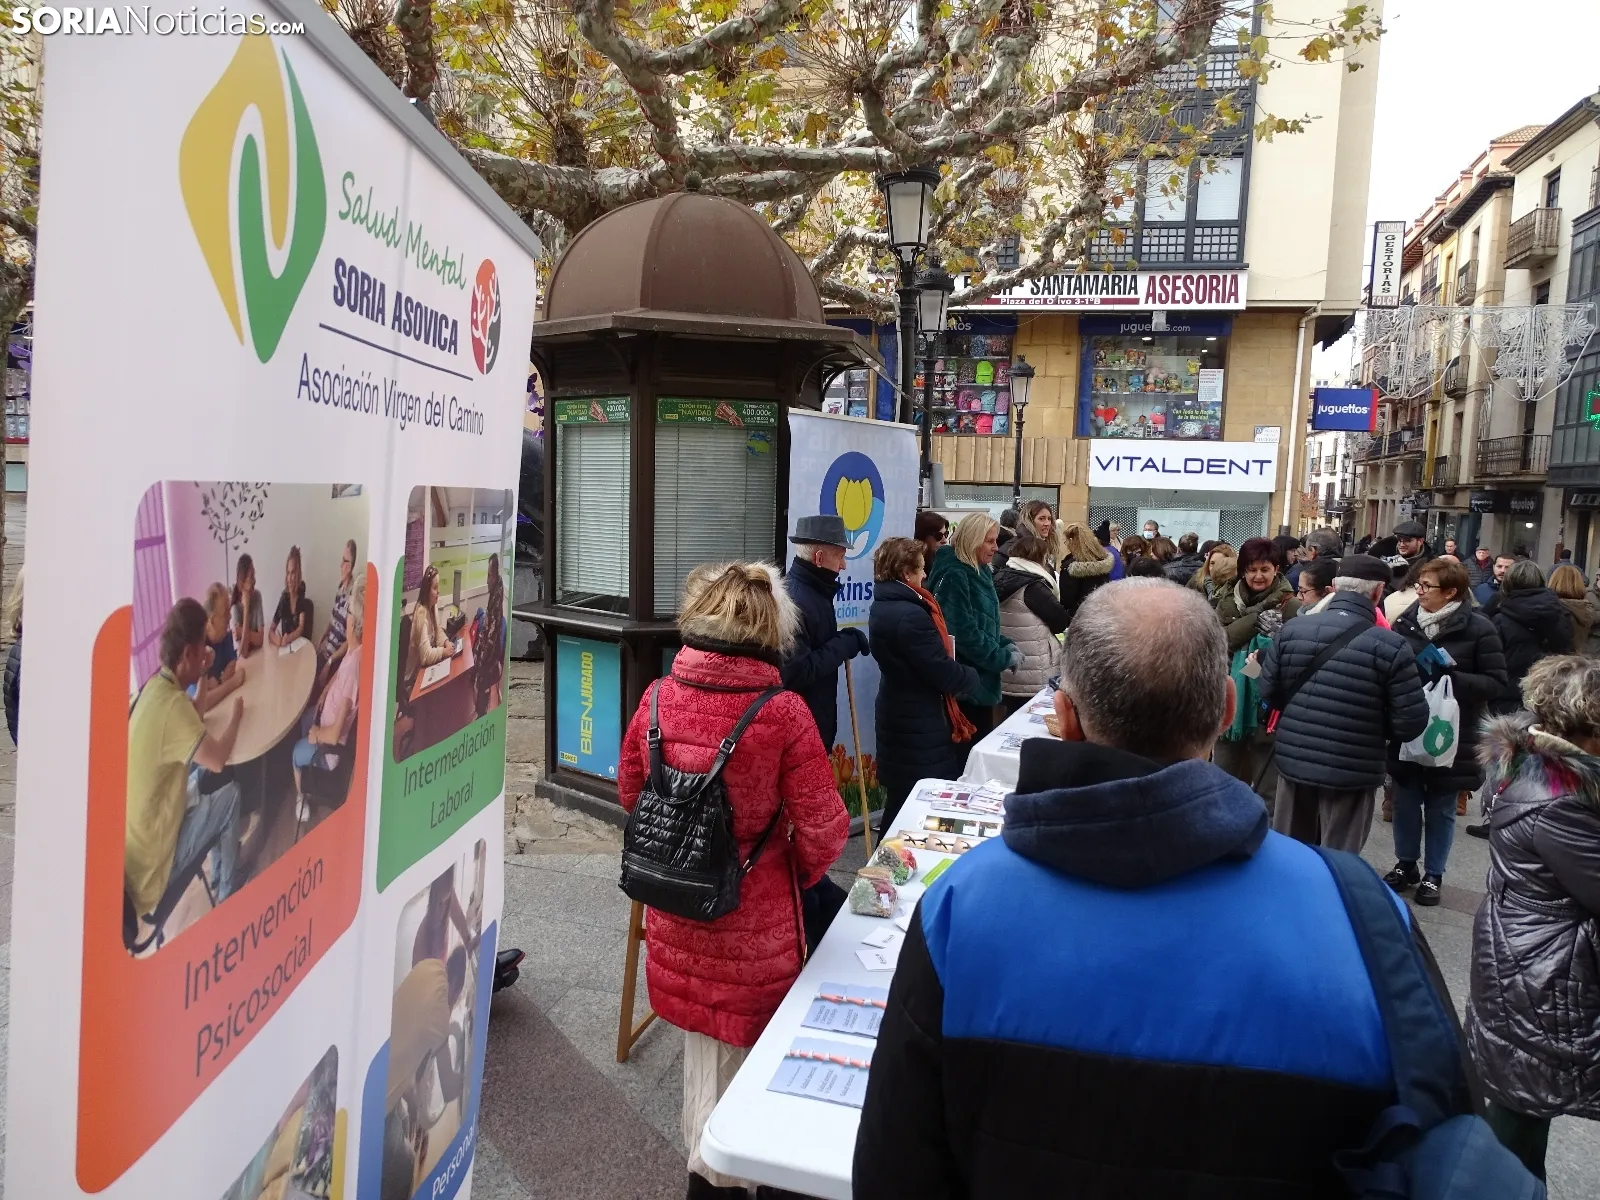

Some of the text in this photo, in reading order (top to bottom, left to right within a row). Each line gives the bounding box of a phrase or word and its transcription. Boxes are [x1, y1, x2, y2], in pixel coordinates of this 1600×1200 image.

[338, 171, 467, 290] Salud Mental
[1381, 235, 1396, 294] GESTORIAS
[333, 257, 458, 355] SORIA ASOVICA
[1000, 297, 1026, 306] Plaza
[1029, 297, 1043, 306] del
[1047, 297, 1071, 306] Oivo
[1030, 274, 1138, 296] SANTAMARIA
[1144, 273, 1240, 305] ASESORIA
[1371, 296, 1398, 306] FOLCH
[297, 352, 485, 436] Asociación Virgen del Camino
[1317, 403, 1368, 415] juguettos
[1095, 455, 1272, 475] VITALDENT
[403, 719, 495, 798] Intermediación
[430, 769, 475, 829] Laboral
[185, 856, 324, 1010] Intervención
[196, 917, 313, 1078] Psicosocial
[432, 1112, 476, 1200] Personal
